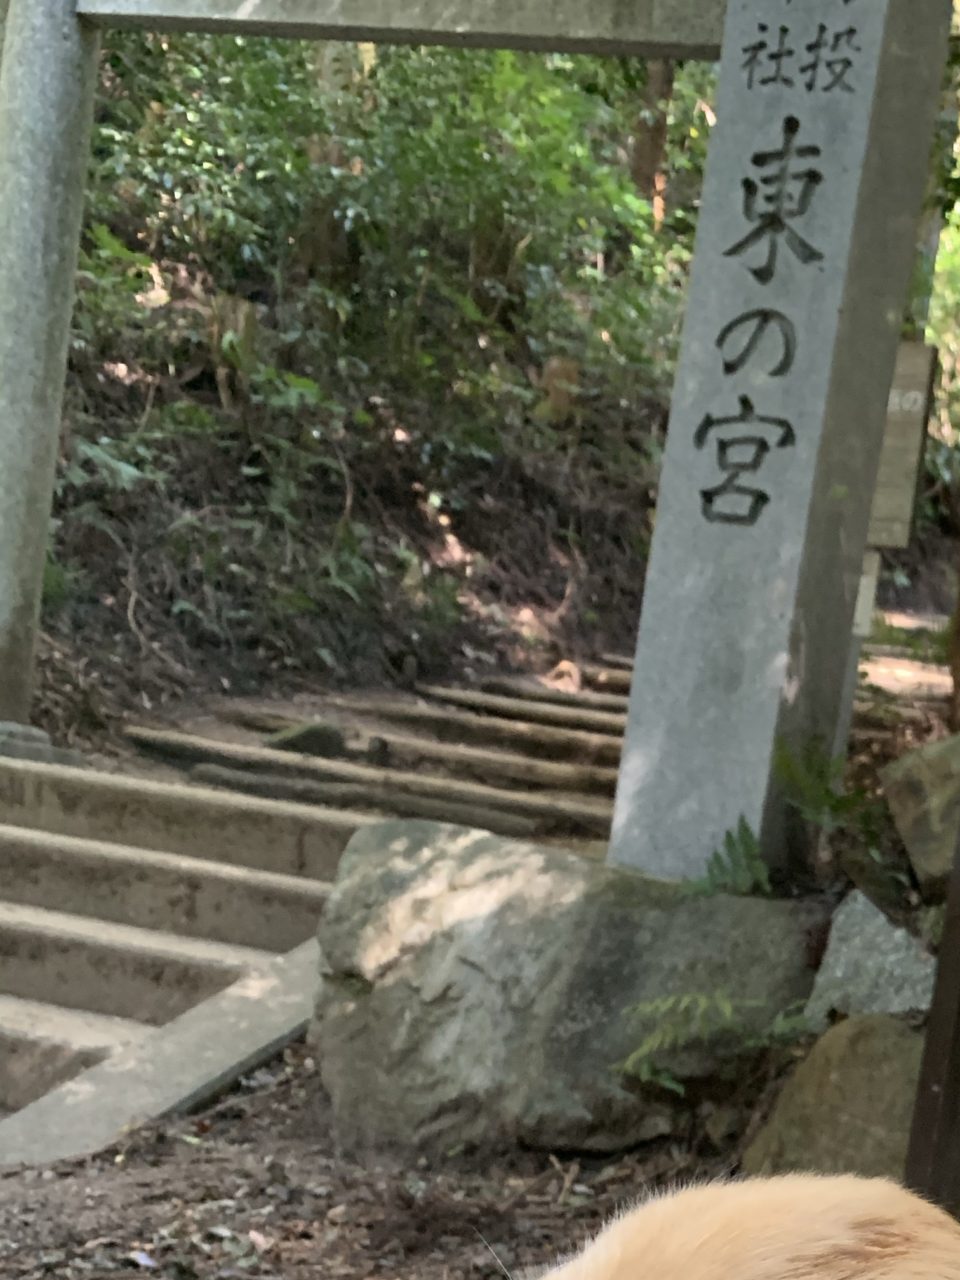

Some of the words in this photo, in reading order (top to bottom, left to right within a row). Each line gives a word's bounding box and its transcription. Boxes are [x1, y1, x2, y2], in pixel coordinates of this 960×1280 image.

[741, 0, 795, 91] 社
[800, 0, 862, 93] 投
[694, 115, 825, 527] 東の宮
